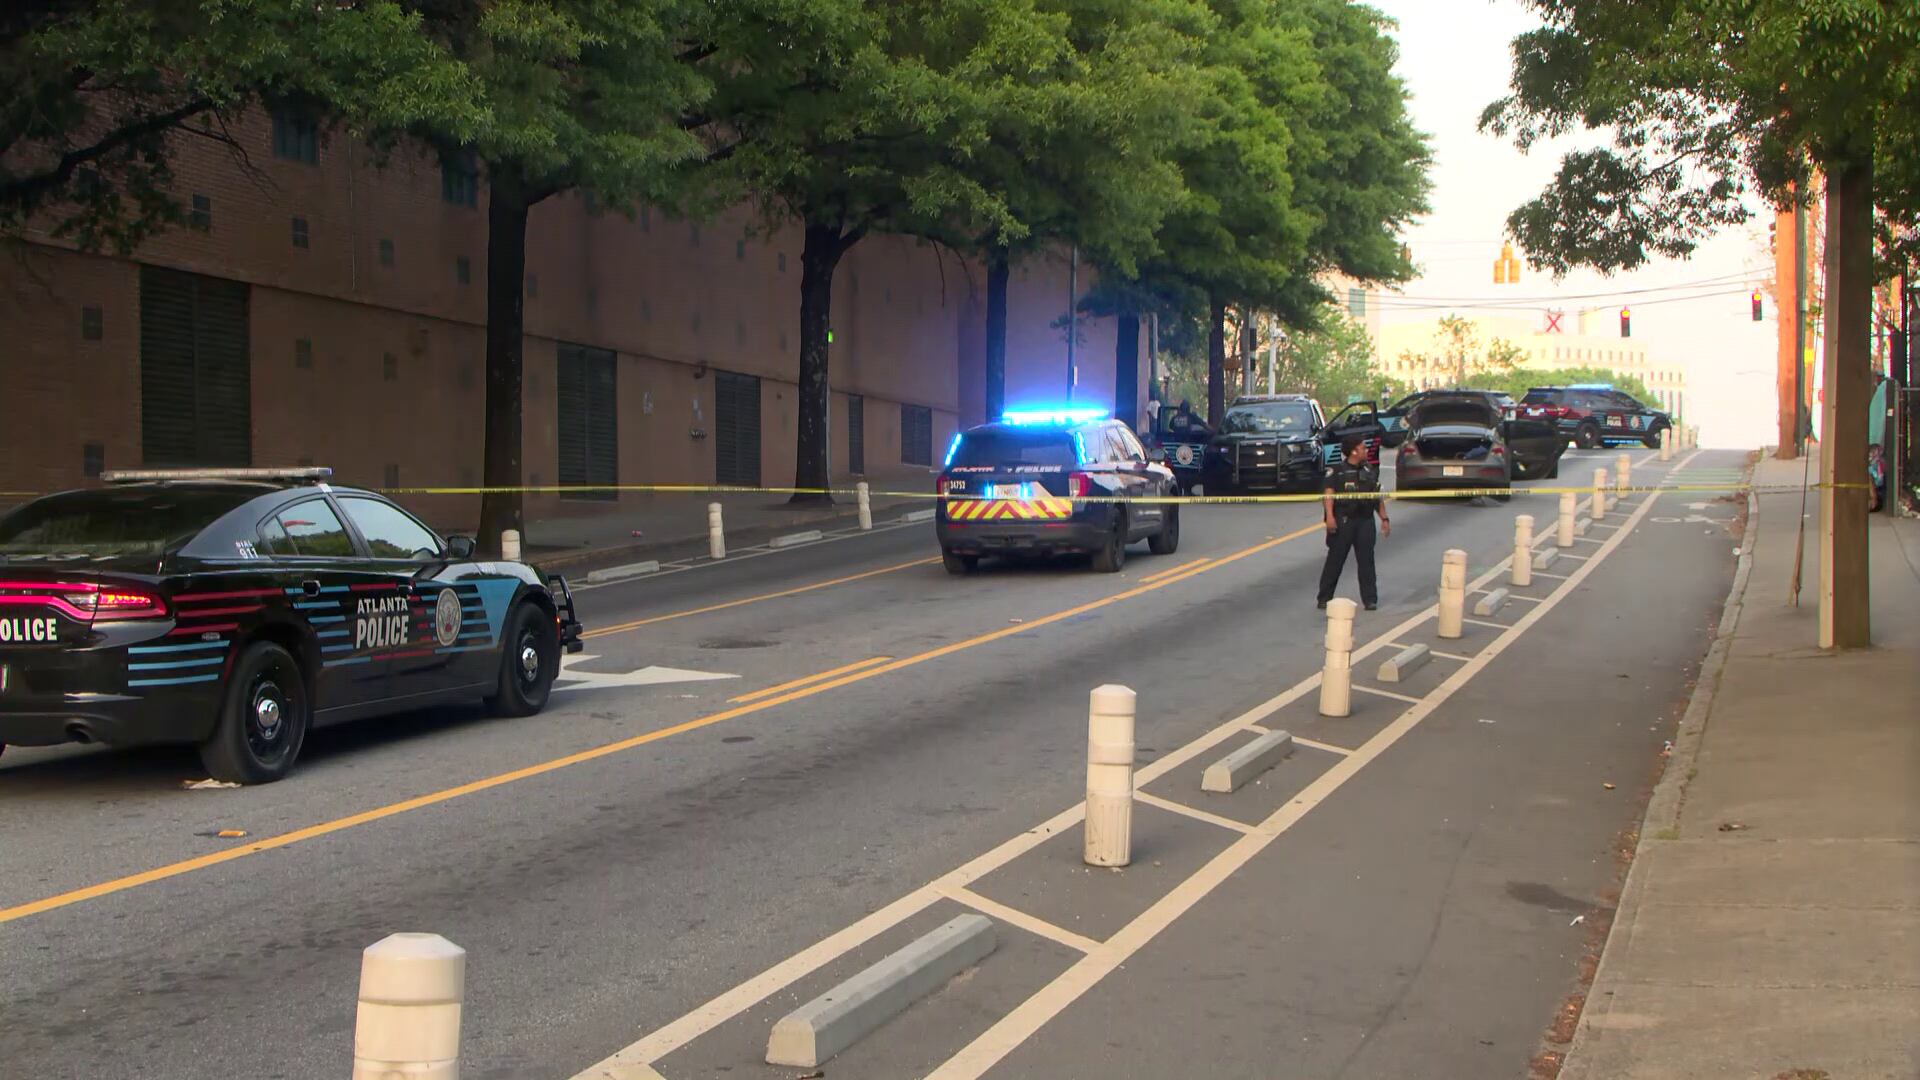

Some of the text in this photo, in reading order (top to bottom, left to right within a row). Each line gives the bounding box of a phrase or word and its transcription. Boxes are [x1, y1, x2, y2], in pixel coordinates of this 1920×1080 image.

[239, 547, 259, 559] 911
[357, 596, 409, 614] ATLANTA
[0, 618, 57, 641] OLICE
[356, 615, 409, 649] POLICE
